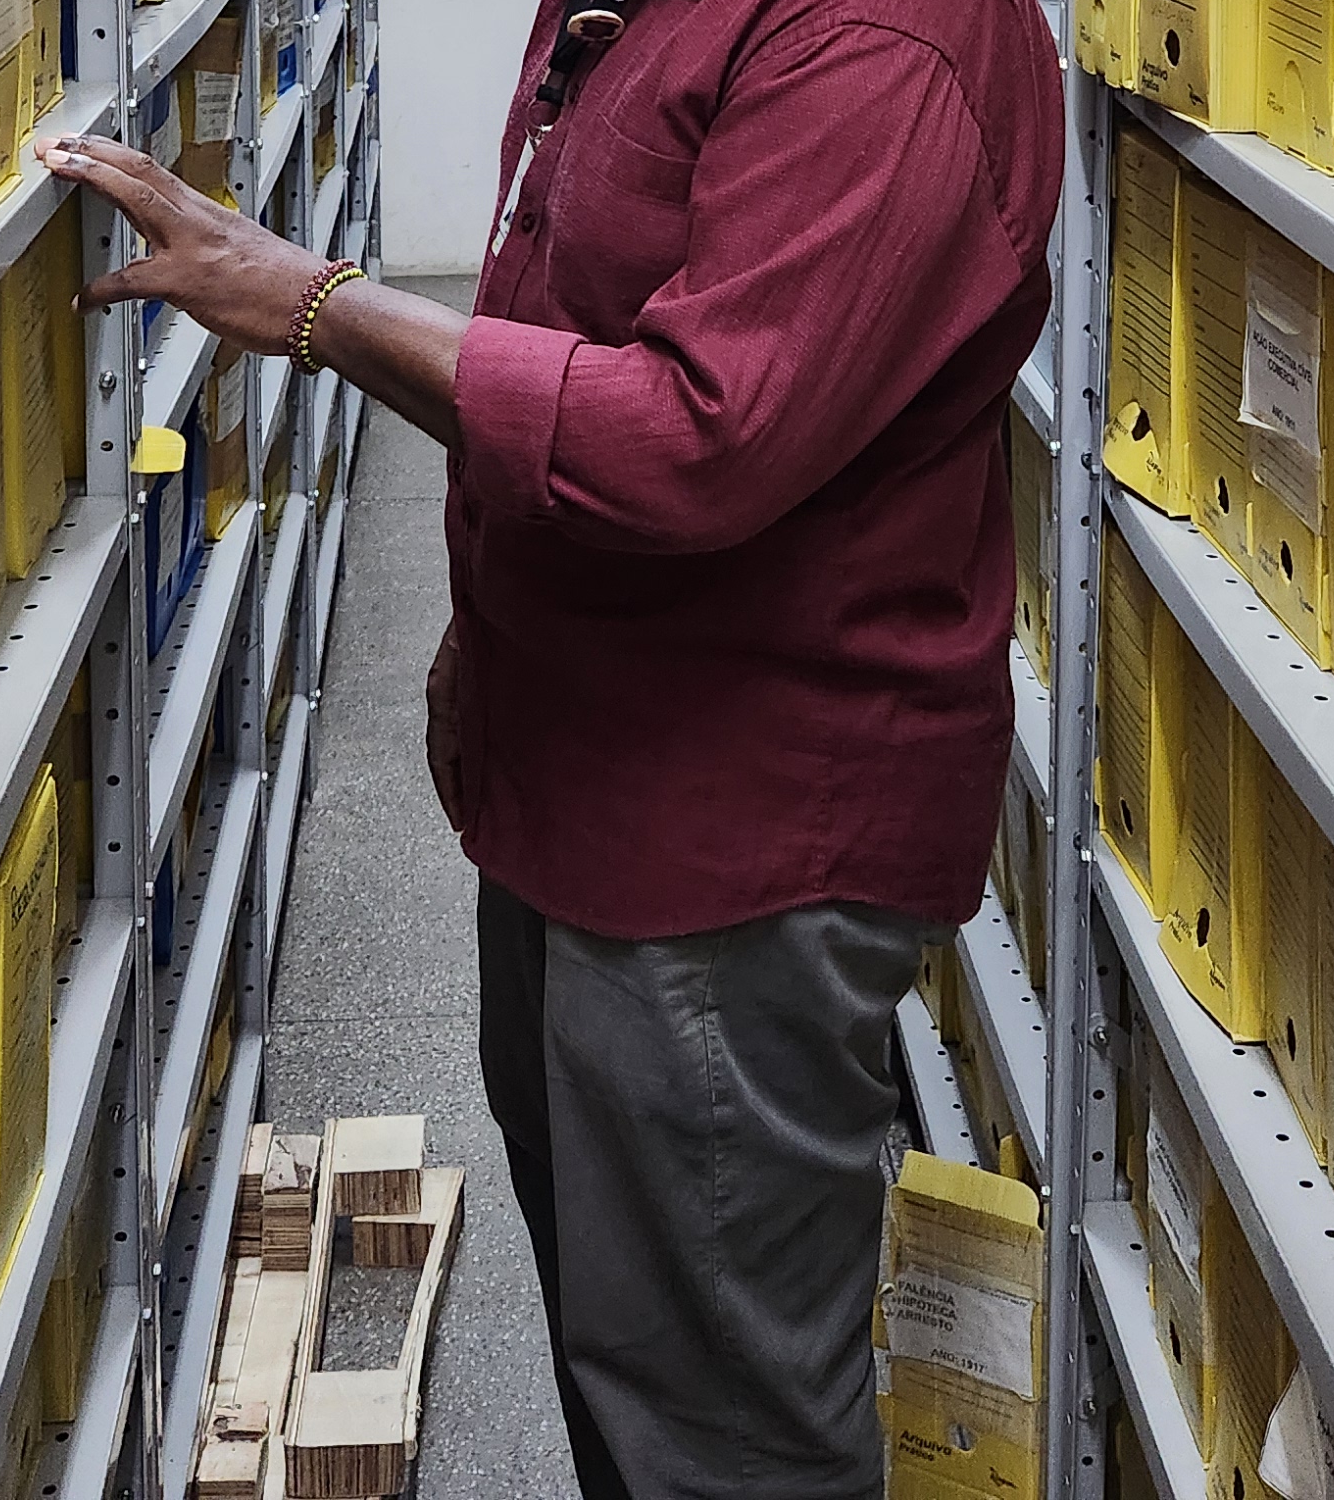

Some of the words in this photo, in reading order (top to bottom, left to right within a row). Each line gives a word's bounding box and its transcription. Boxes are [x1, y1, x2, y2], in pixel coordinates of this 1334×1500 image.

[1142, 58, 1168, 82] Arquivo
[898, 1280, 955, 1306] FALÊNCIA
[896, 1309, 954, 1332] ARRESTO
[898, 1297, 957, 1320] HIPOTECA
[900, 1430, 952, 1456] Arquivo
